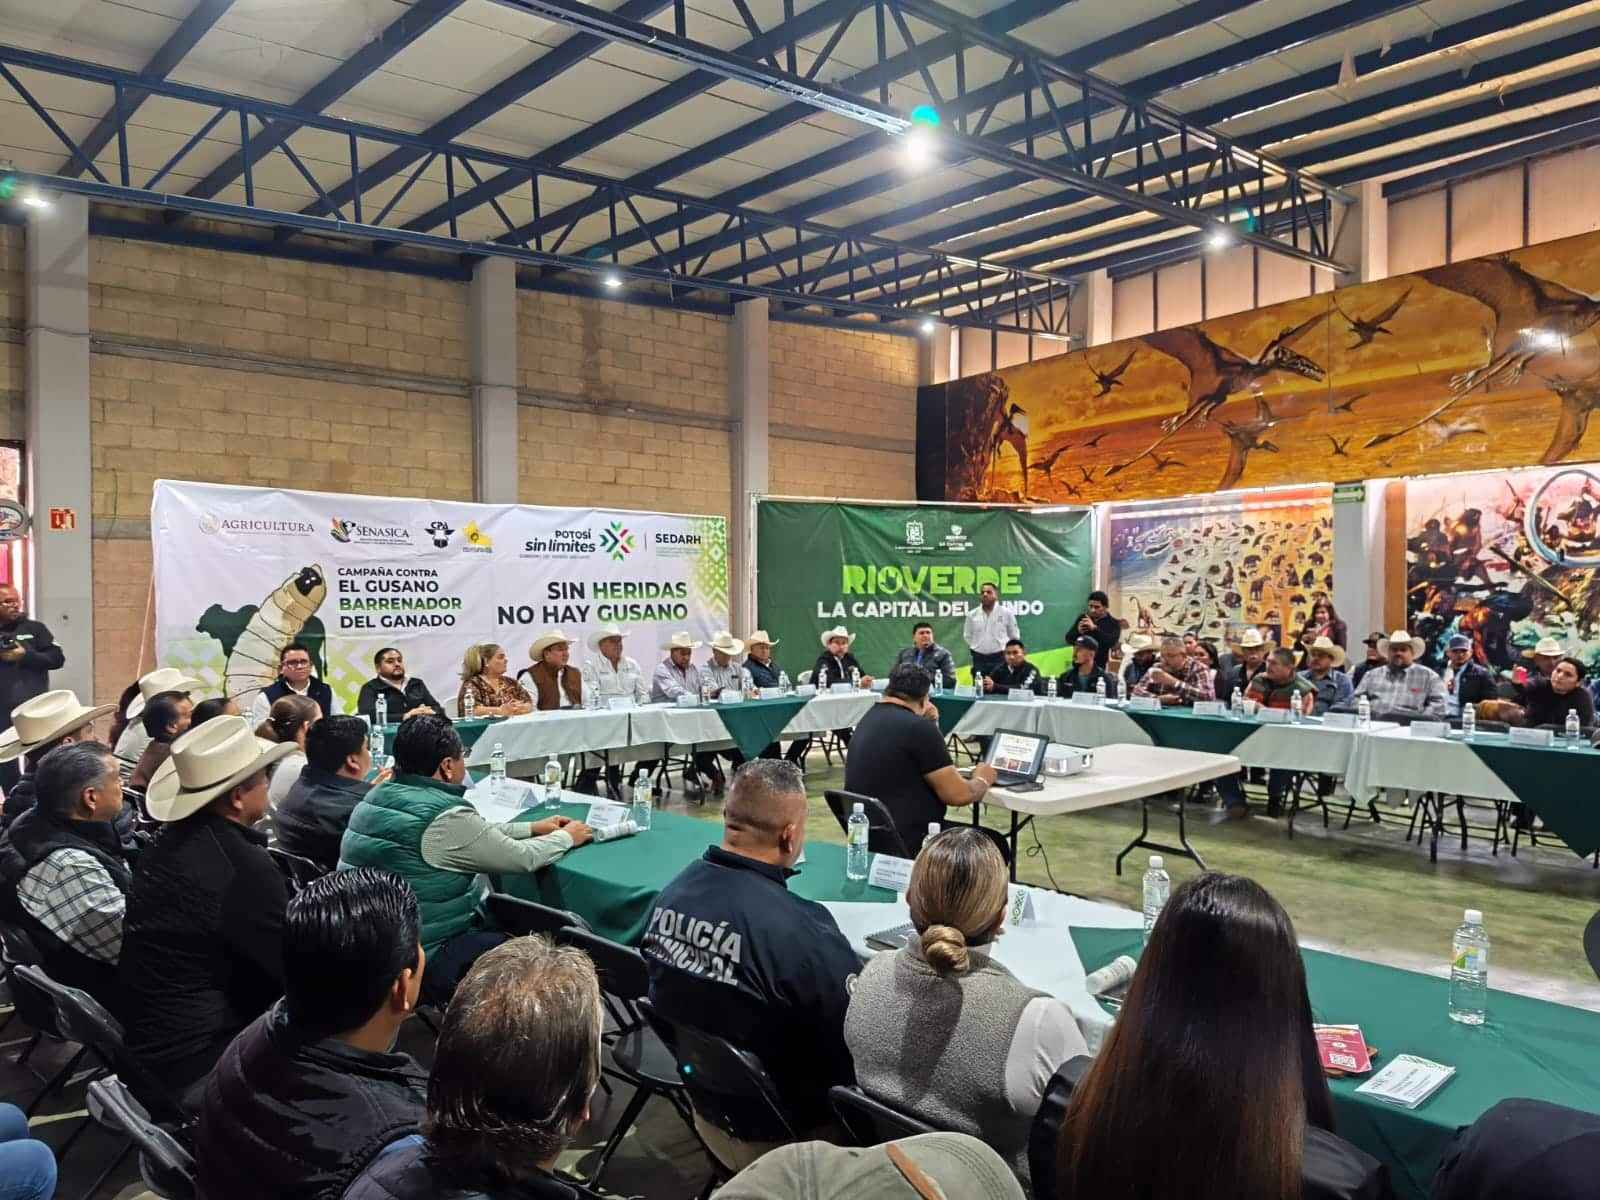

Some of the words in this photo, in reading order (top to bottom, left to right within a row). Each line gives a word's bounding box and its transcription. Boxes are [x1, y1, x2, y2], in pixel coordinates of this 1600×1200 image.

[222, 519, 314, 532] AGRICULTURA
[356, 525, 409, 538] SENASICA
[555, 528, 592, 539] POTOSÍ
[655, 533, 701, 544] SEDARH
[525, 537, 546, 552] sin
[337, 566, 393, 577] CAMPAÑA
[395, 568, 438, 577] CONTRA
[338, 580, 360, 592] EL
[365, 580, 439, 592] GUSANO
[842, 565, 1022, 595] RIOVERDE
[547, 582, 585, 599] SIN
[593, 582, 687, 599] HERIDAS
[339, 597, 462, 610] BARRENADOR
[817, 602, 846, 618] LA
[851, 601, 934, 618] CAPITAL
[497, 606, 534, 624] NO
[542, 605, 590, 624] HAY
[597, 603, 688, 622] GUSANO
[340, 615, 376, 628] DEL
[380, 614, 455, 628] GANADO
[648, 906, 742, 964] POLICÍA
